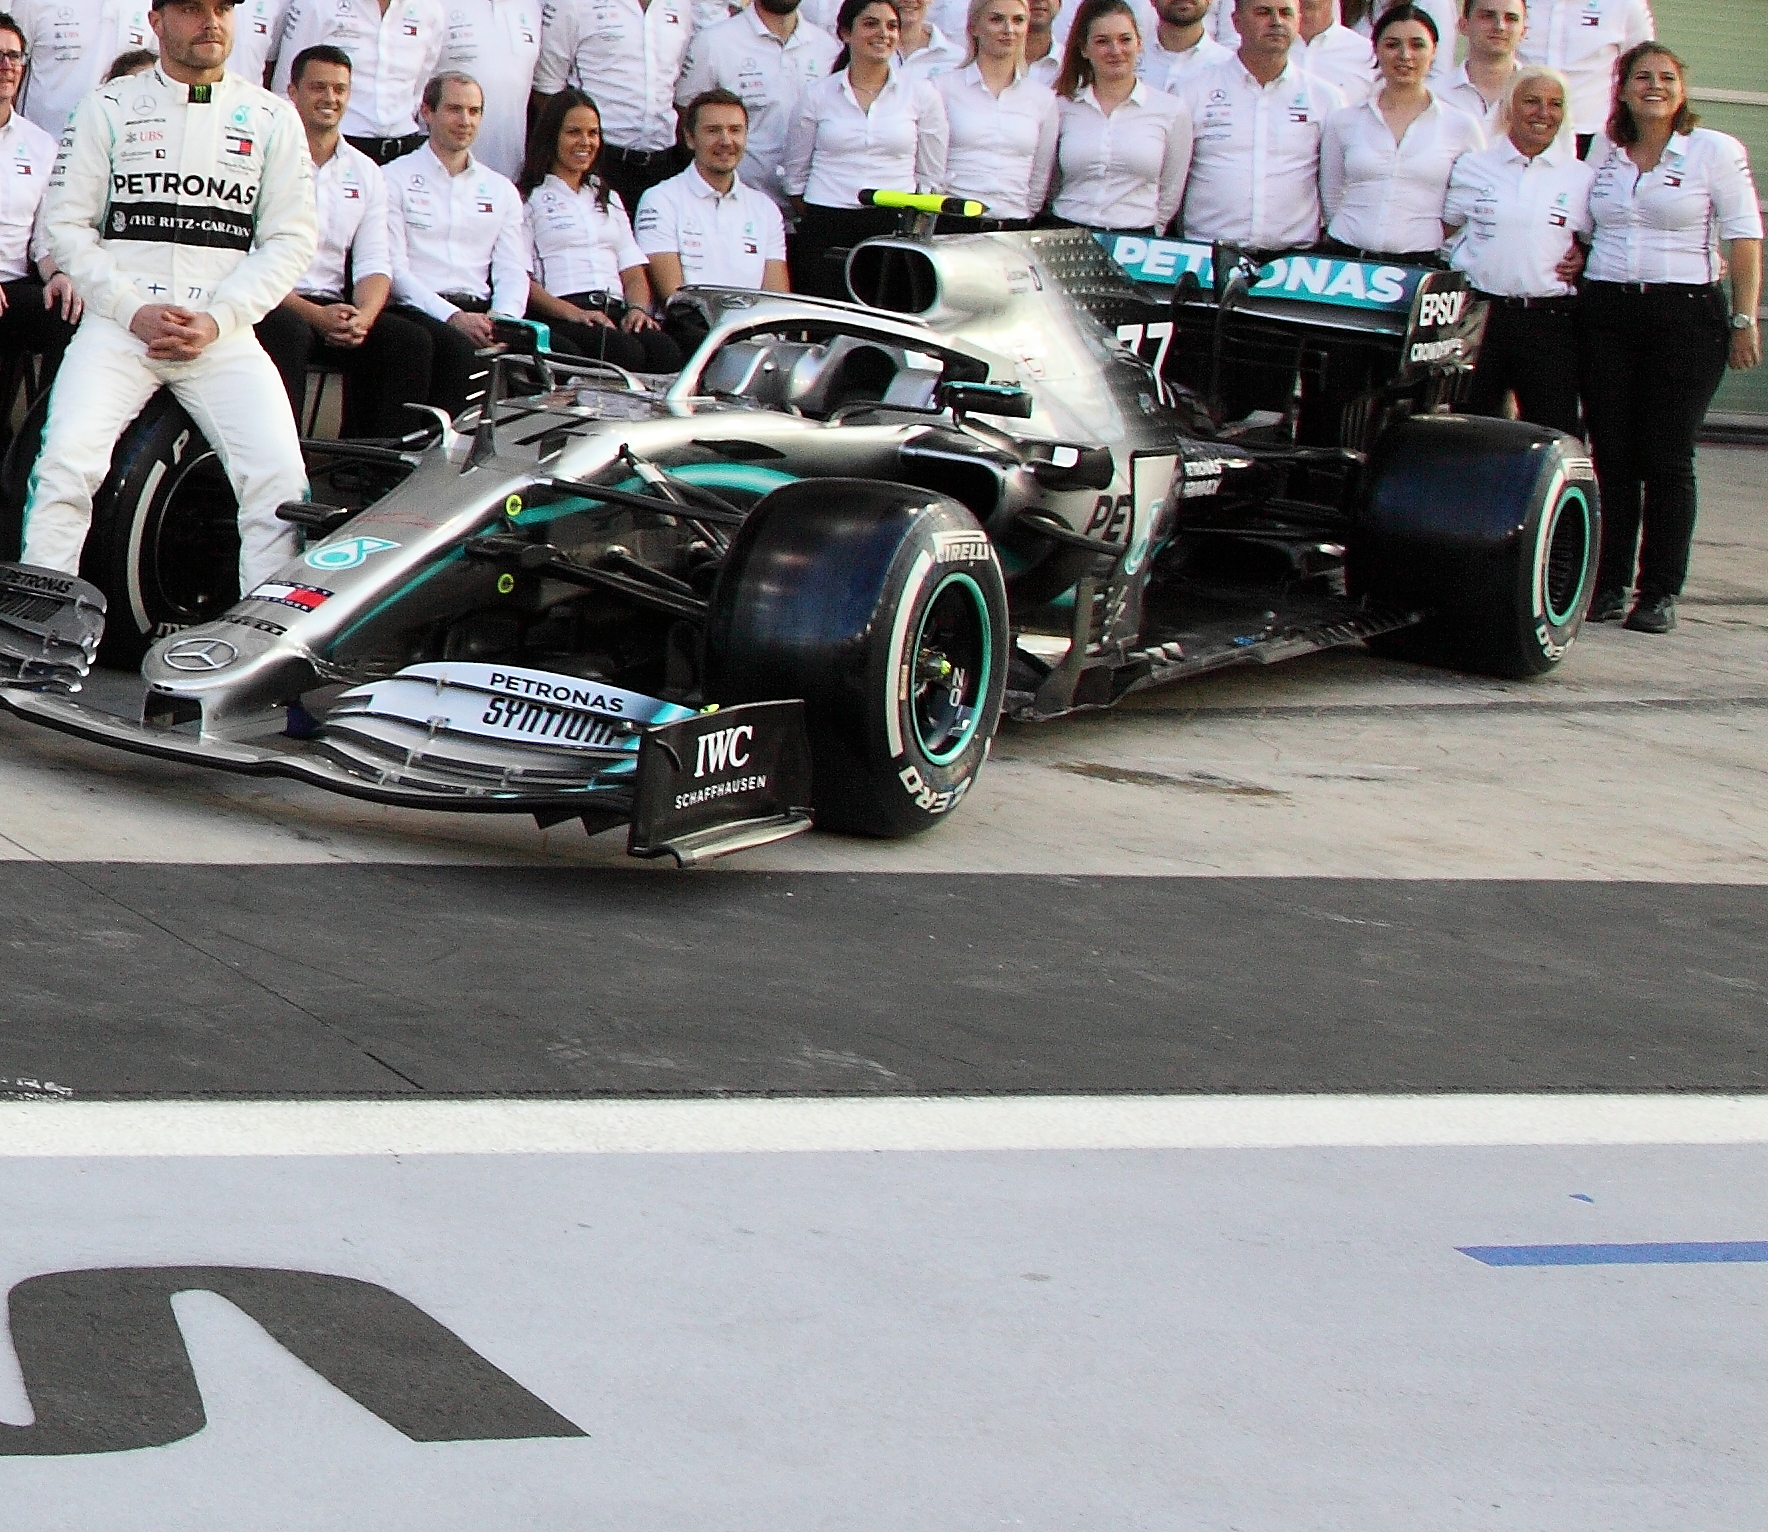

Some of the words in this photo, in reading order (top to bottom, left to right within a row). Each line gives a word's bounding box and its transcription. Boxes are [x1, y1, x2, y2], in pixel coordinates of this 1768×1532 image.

[139, 131, 164, 142] UBS
[113, 172, 257, 205] PETRONAS
[1113, 236, 1408, 304] PETONAS
[1115, 320, 1175, 407] 77
[931, 529, 991, 564] PIRELLI
[489, 671, 625, 713] PETRONAS
[693, 724, 754, 779] IWC
[674, 773, 768, 811] SCHAFFHAUSEN
